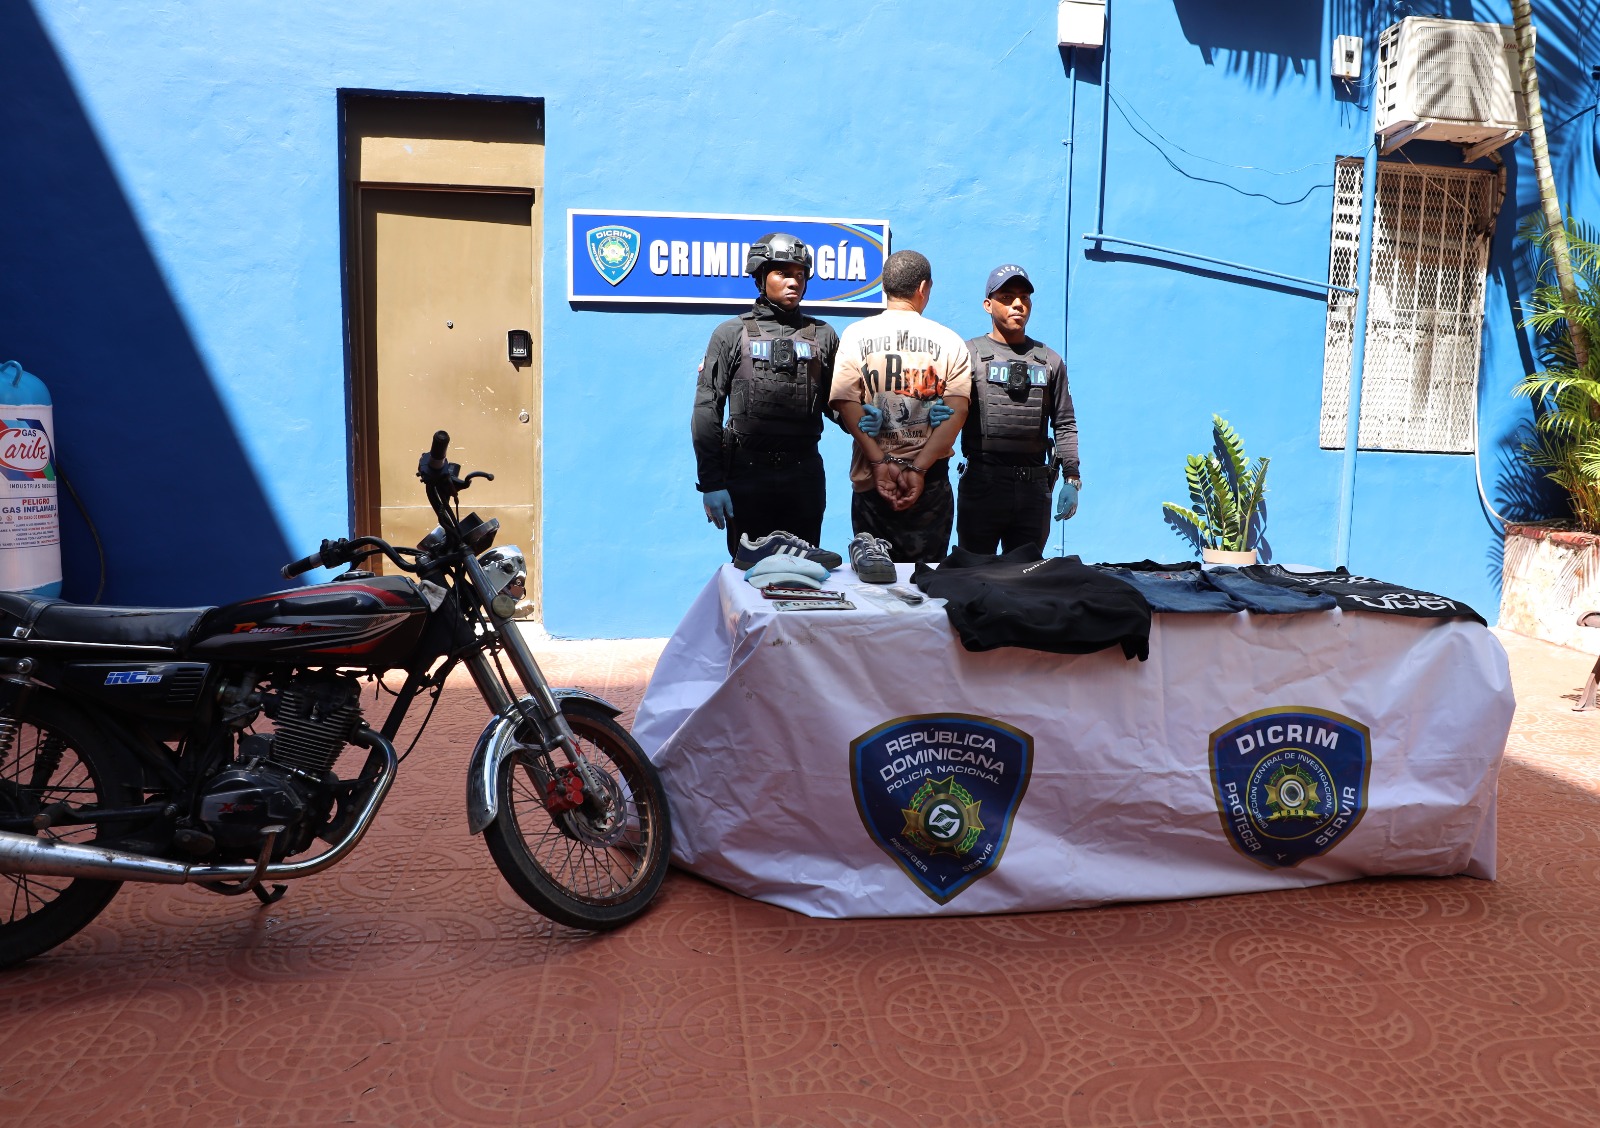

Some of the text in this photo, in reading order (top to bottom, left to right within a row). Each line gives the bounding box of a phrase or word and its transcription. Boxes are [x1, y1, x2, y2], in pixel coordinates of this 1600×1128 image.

[595, 230, 633, 240] DICRIM
[752, 341, 812, 358] DIM
[896, 329, 942, 362] Money
[989, 365, 1046, 384] POÍA
[21, 429, 37, 437] GAS
[2, 506, 22, 514] GAS
[22, 498, 50, 506] PELIGRO
[144, 675, 161, 683] TIRE
[885, 728, 996, 757] REPÚBLICA
[1235, 724, 1339, 756] DICRIM
[879, 748, 1005, 782] DOMINICANA
[886, 765, 1000, 794] POLICÍA NACIONAL
[1253, 754, 1283, 785] CENTRAL
[1284, 752, 1296, 760] DE
[1225, 781, 1356, 861] PROTEGER Y SERVIR
[889, 837, 994, 883] PROTEGER Y SERVIR
